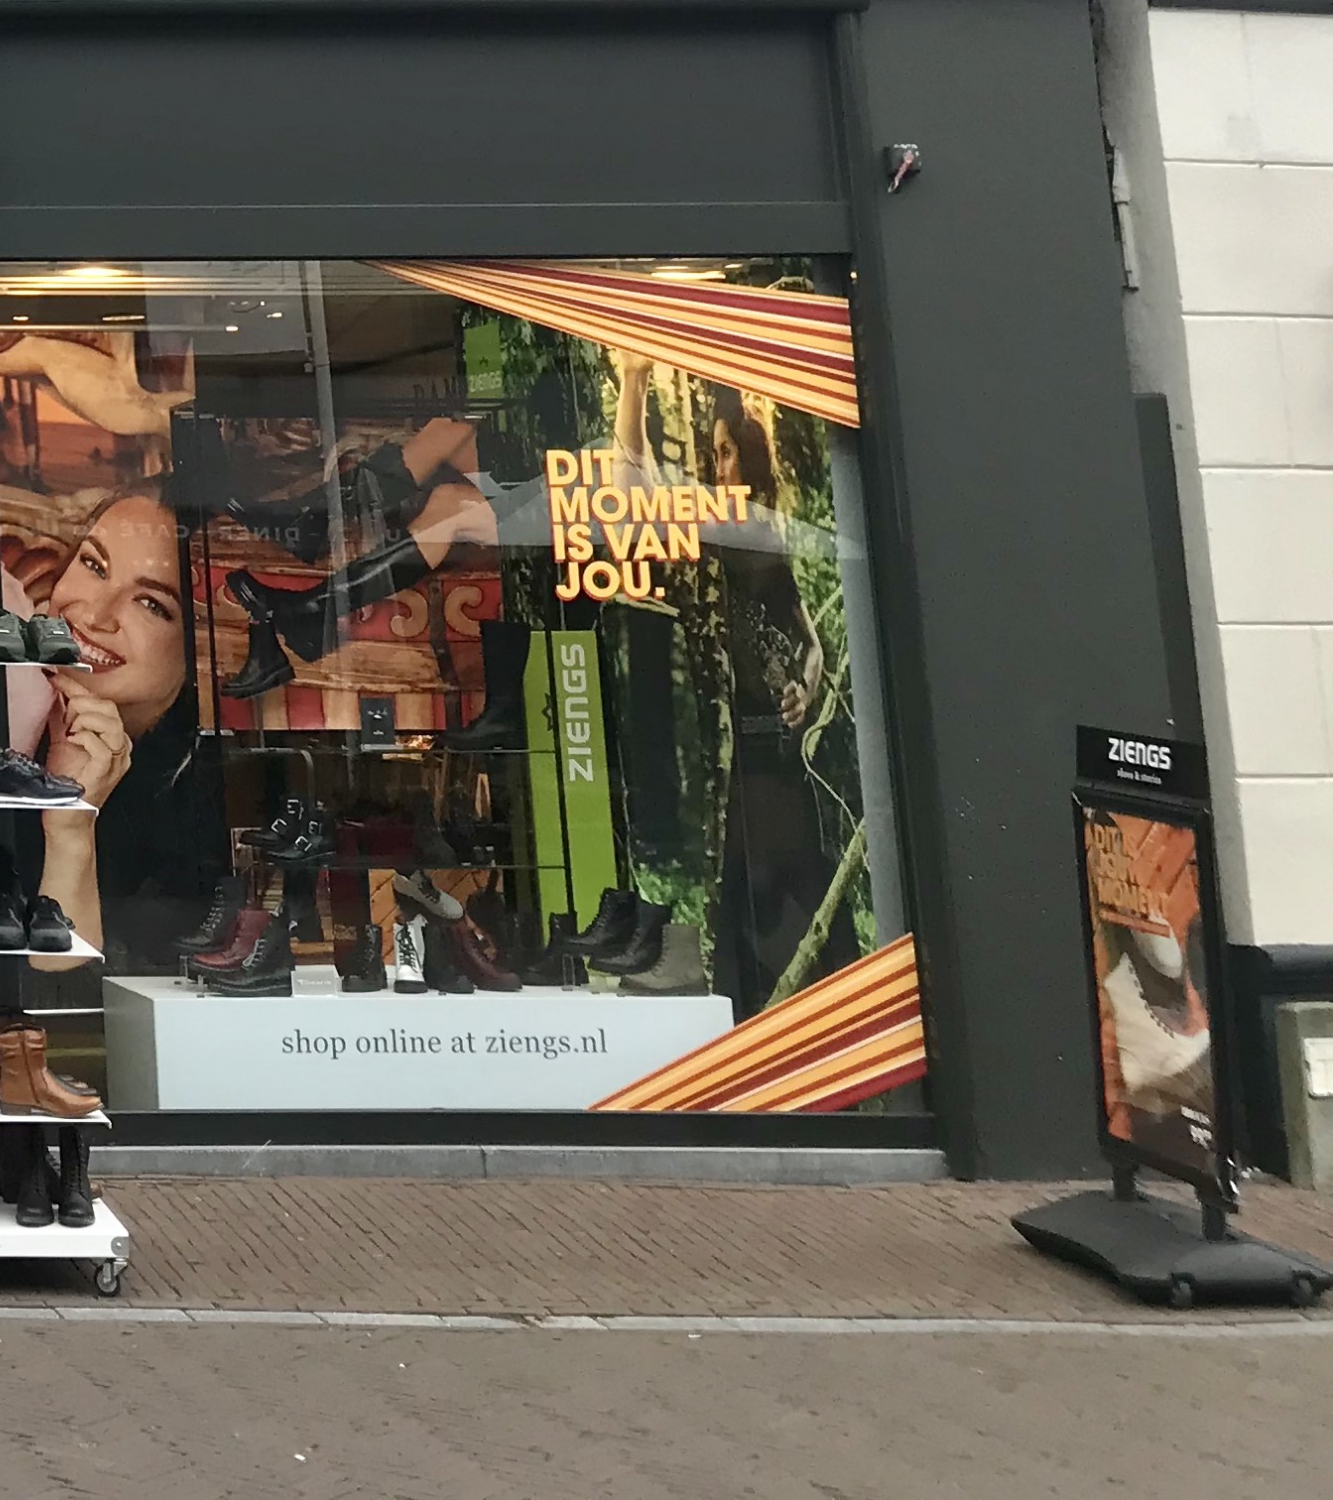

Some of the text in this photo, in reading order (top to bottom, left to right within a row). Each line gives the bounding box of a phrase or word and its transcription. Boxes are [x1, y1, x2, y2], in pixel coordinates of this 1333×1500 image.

[545, 449, 615, 487] DIT
[549, 485, 752, 523] MOMENT
[552, 522, 701, 563] IS VAN
[555, 561, 666, 601] JOU.
[560, 643, 594, 782] ZIENGS
[1108, 737, 1172, 771] ZIENGS
[282, 1028, 608, 1060] shop online at ziengs.nl
